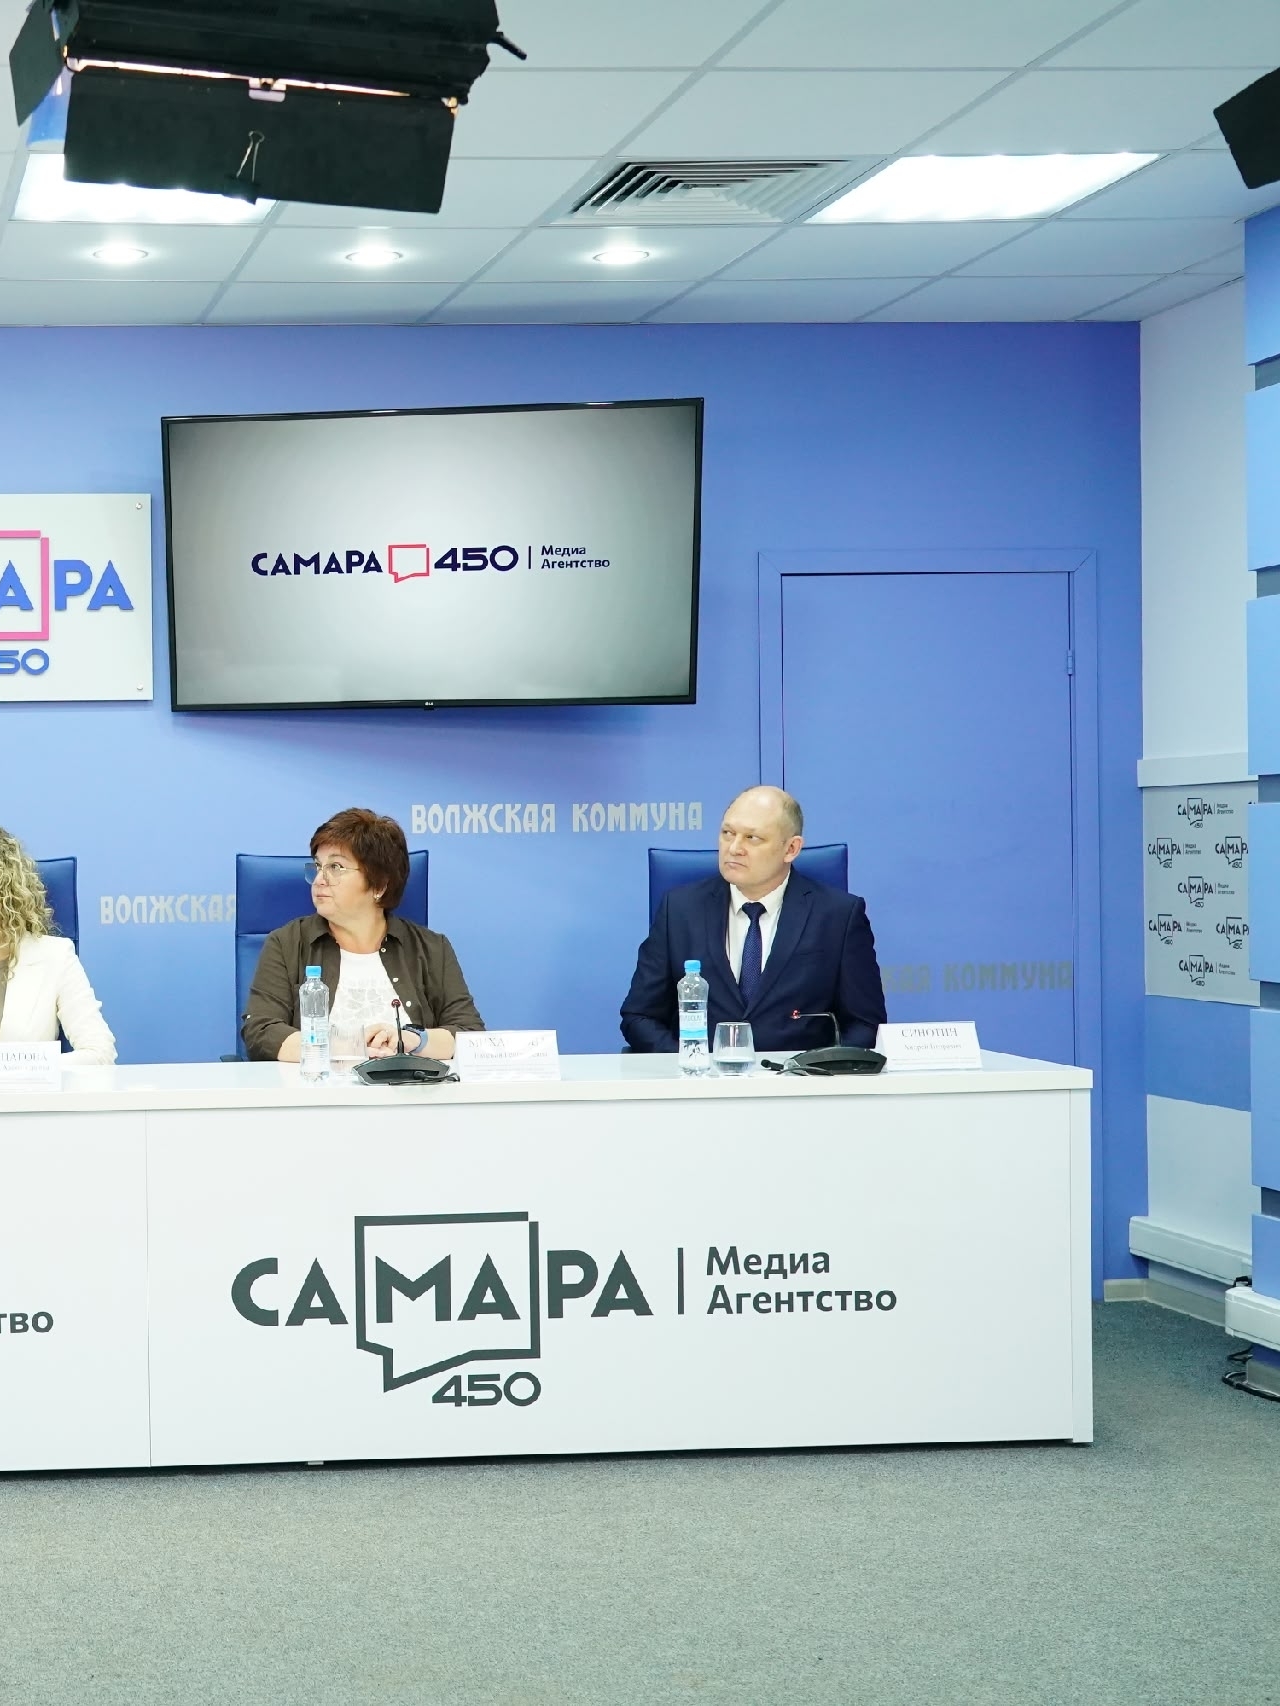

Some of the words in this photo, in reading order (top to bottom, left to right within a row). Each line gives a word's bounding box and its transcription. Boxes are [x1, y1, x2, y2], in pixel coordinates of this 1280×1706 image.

[251, 550, 383, 576] САМАРА
[434, 545, 519, 571] 450
[541, 545, 586, 556] Медиа
[541, 557, 610, 569] Агентство
[411, 803, 555, 833] ВОЛЖСКАЯ
[573, 802, 702, 832] КОММУНА
[1216, 924, 1249, 935] САМАР
[943, 960, 1072, 992] КОММУНА
[706, 1246, 830, 1279] Медиа
[231, 1249, 654, 1327] САМАРА
[706, 1283, 898, 1315] Агентство
[431, 1371, 541, 1408] 450
